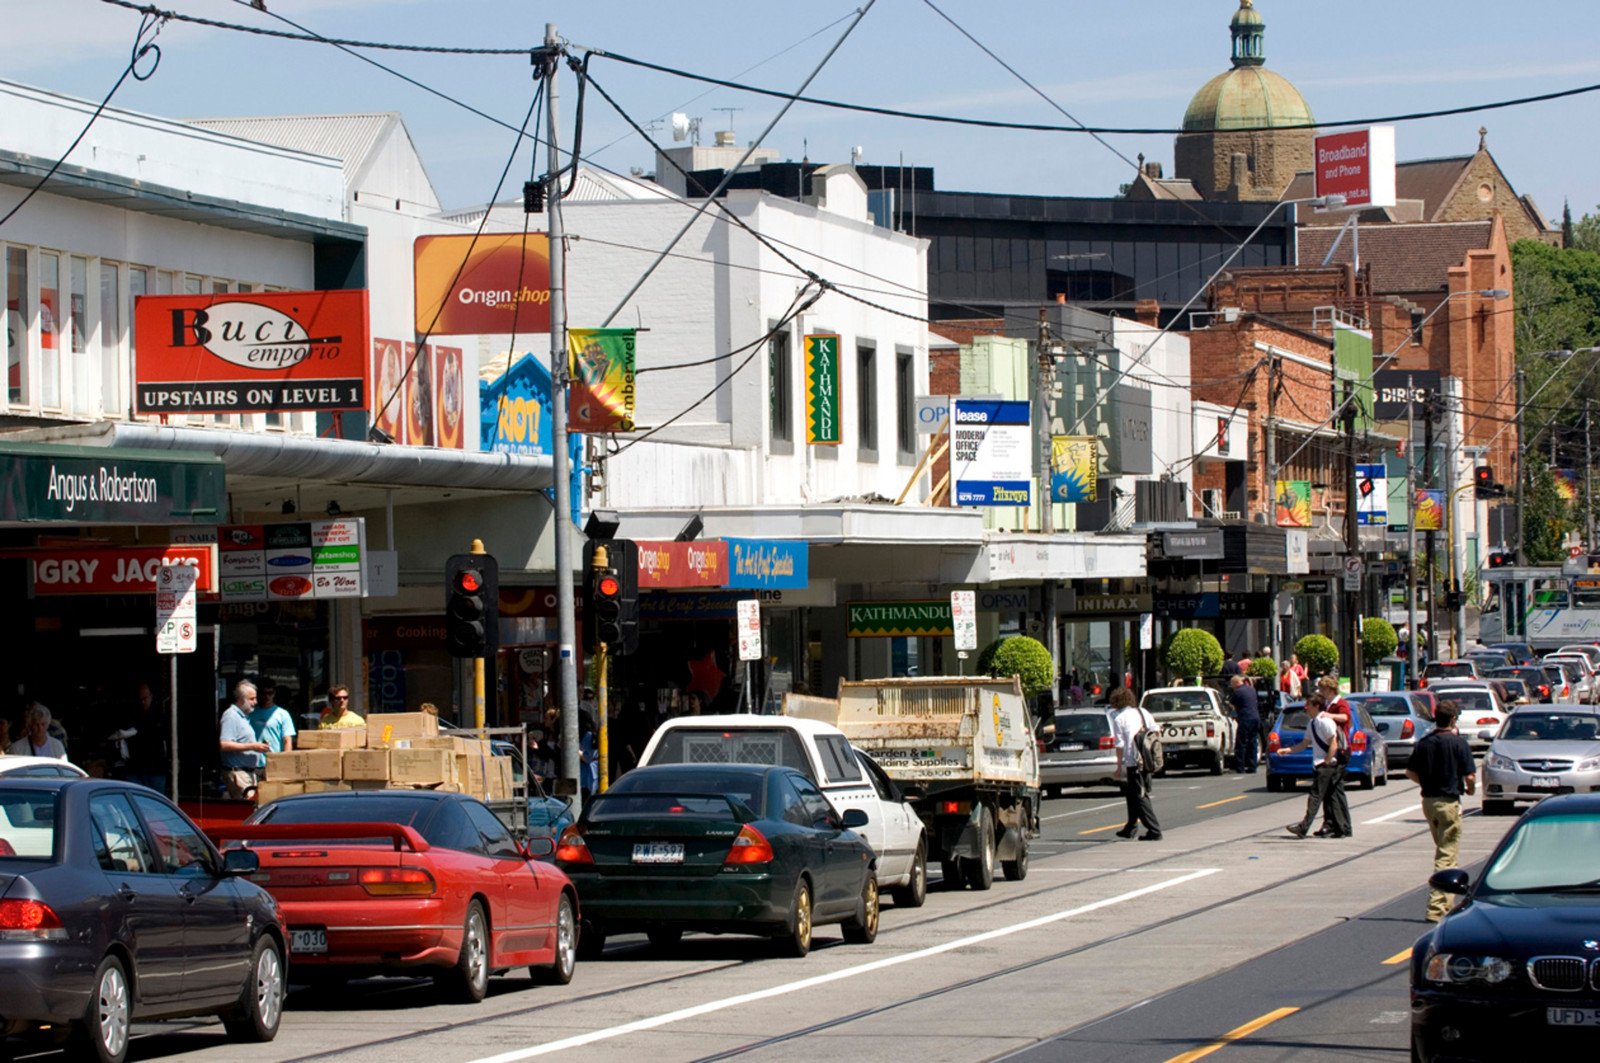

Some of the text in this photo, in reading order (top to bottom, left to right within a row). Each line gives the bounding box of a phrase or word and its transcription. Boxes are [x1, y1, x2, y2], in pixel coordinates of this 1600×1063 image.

[1319, 143, 1367, 163] Broadband
[1325, 165, 1361, 179] and Phone
[459, 286, 550, 307] Origin shop
[168, 307, 299, 347] Buci
[248, 344, 339, 366] emporio
[621, 328, 636, 432] Camberwell
[818, 338, 833, 441] KATHMANDU
[144, 387, 358, 407] UPSTAIRS ON LEVEL 1
[497, 395, 541, 445] RIOT!
[956, 408, 988, 422] lease
[955, 430, 985, 441] MODERN
[955, 441, 979, 451] OFFICE
[955, 451, 977, 461] SPACE
[1087, 438, 1097, 503] Camberwell
[48, 465, 157, 512] Angus & Robertson
[316, 576, 357, 588] Bo Won
[981, 593, 1027, 609] OPSM
[851, 606, 951, 624] KATHMANDU
[396, 626, 448, 640] Cooking
[910, 748, 919, 758] &
